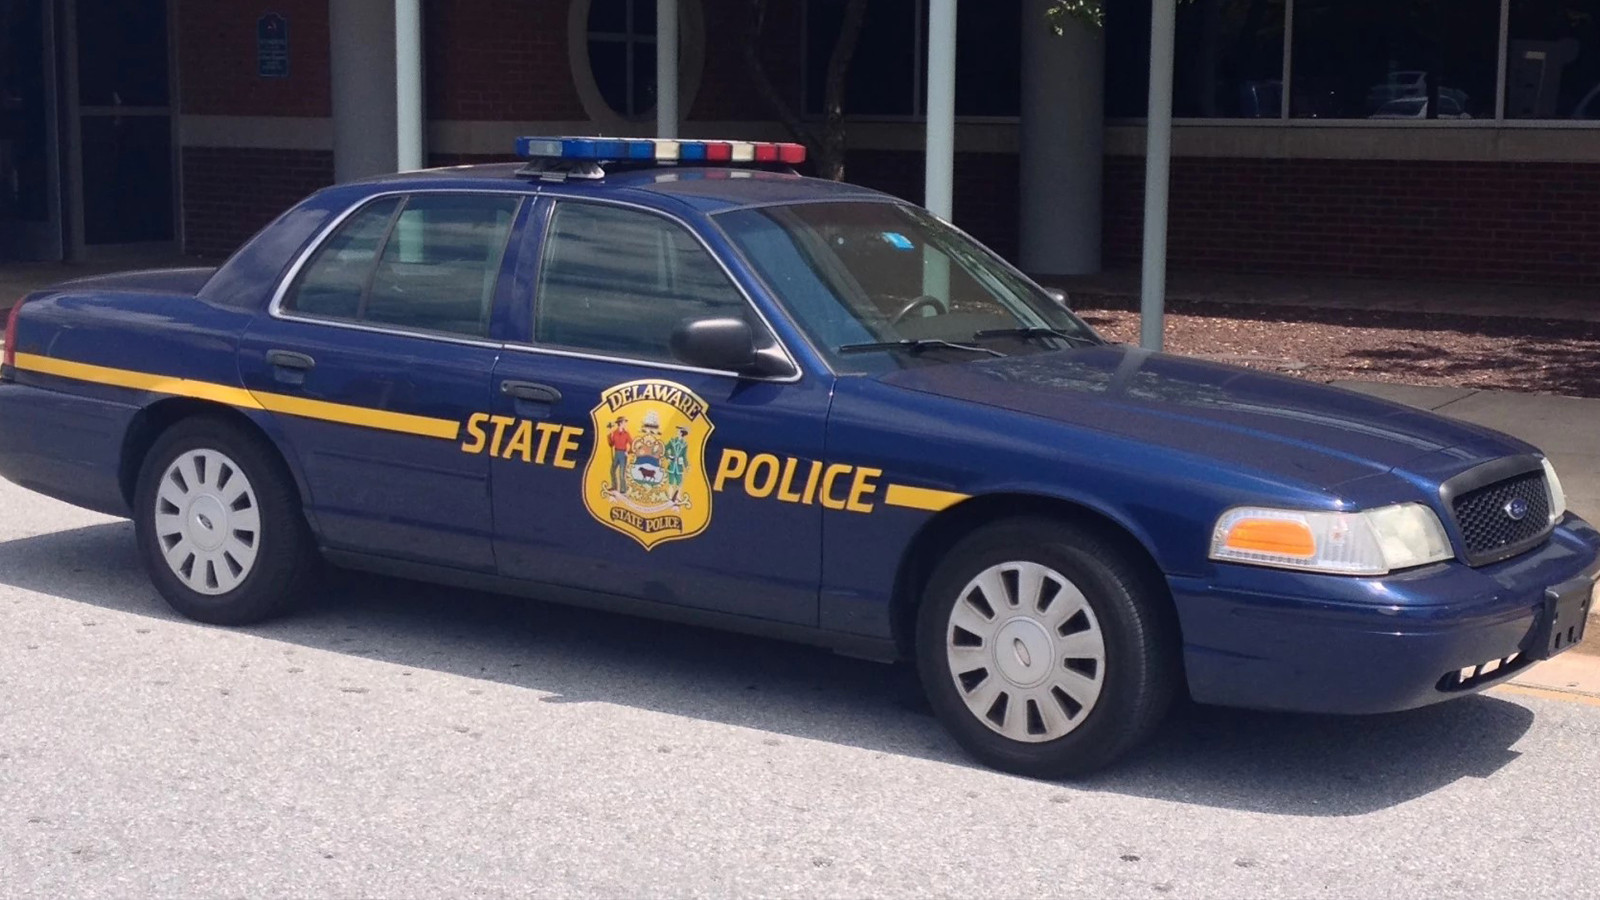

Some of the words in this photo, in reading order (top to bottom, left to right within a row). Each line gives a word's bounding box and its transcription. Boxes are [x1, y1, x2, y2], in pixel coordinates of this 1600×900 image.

[608, 384, 702, 418] DELAWARE
[461, 412, 584, 469] STATE
[713, 448, 882, 513] POLICE
[611, 507, 644, 529] STATE
[645, 516, 681, 532] POLICE
